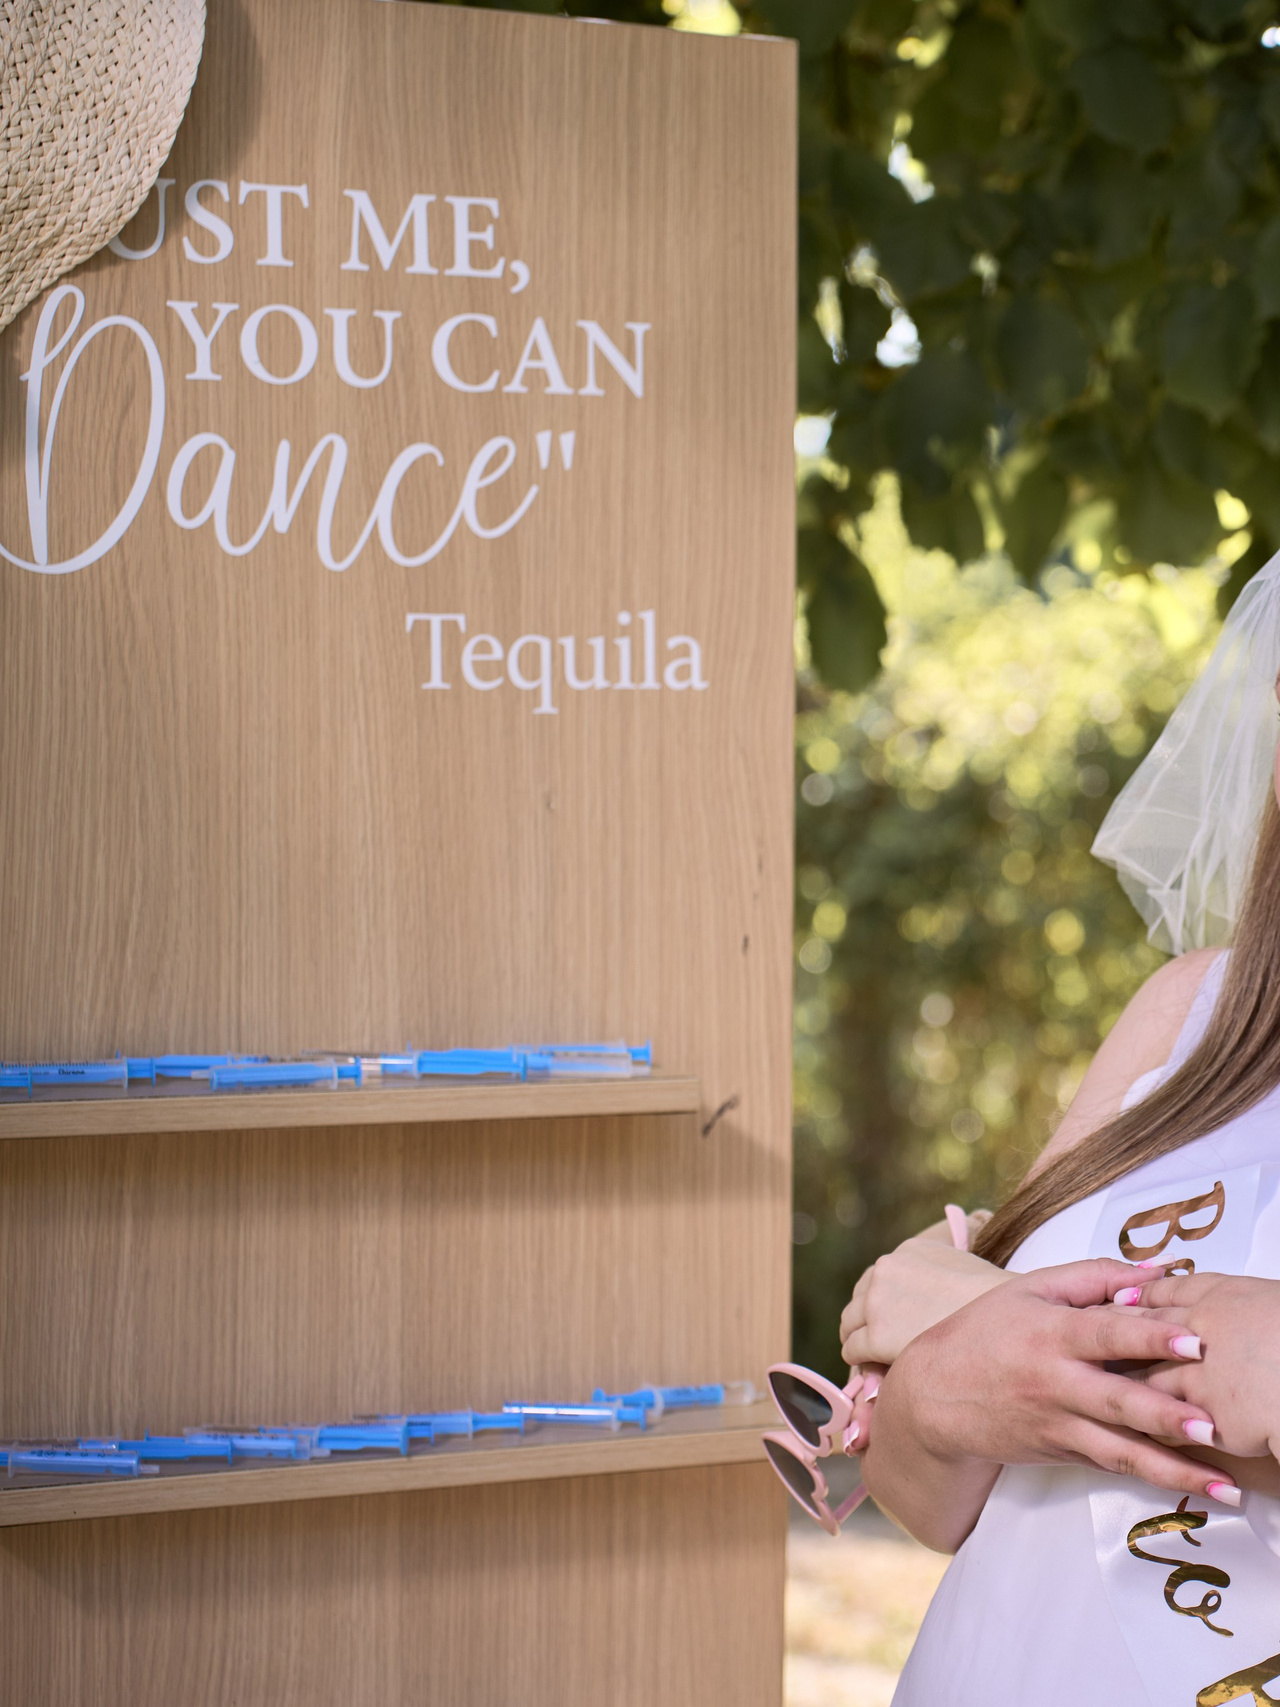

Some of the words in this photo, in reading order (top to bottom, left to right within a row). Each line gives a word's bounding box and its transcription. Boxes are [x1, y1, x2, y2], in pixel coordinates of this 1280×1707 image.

[107, 178, 309, 267] UST
[340, 188, 531, 294] ME,
[165, 300, 403, 389] YOU
[431, 312, 652, 399] CAN
[405, 609, 709, 715] Tequila
